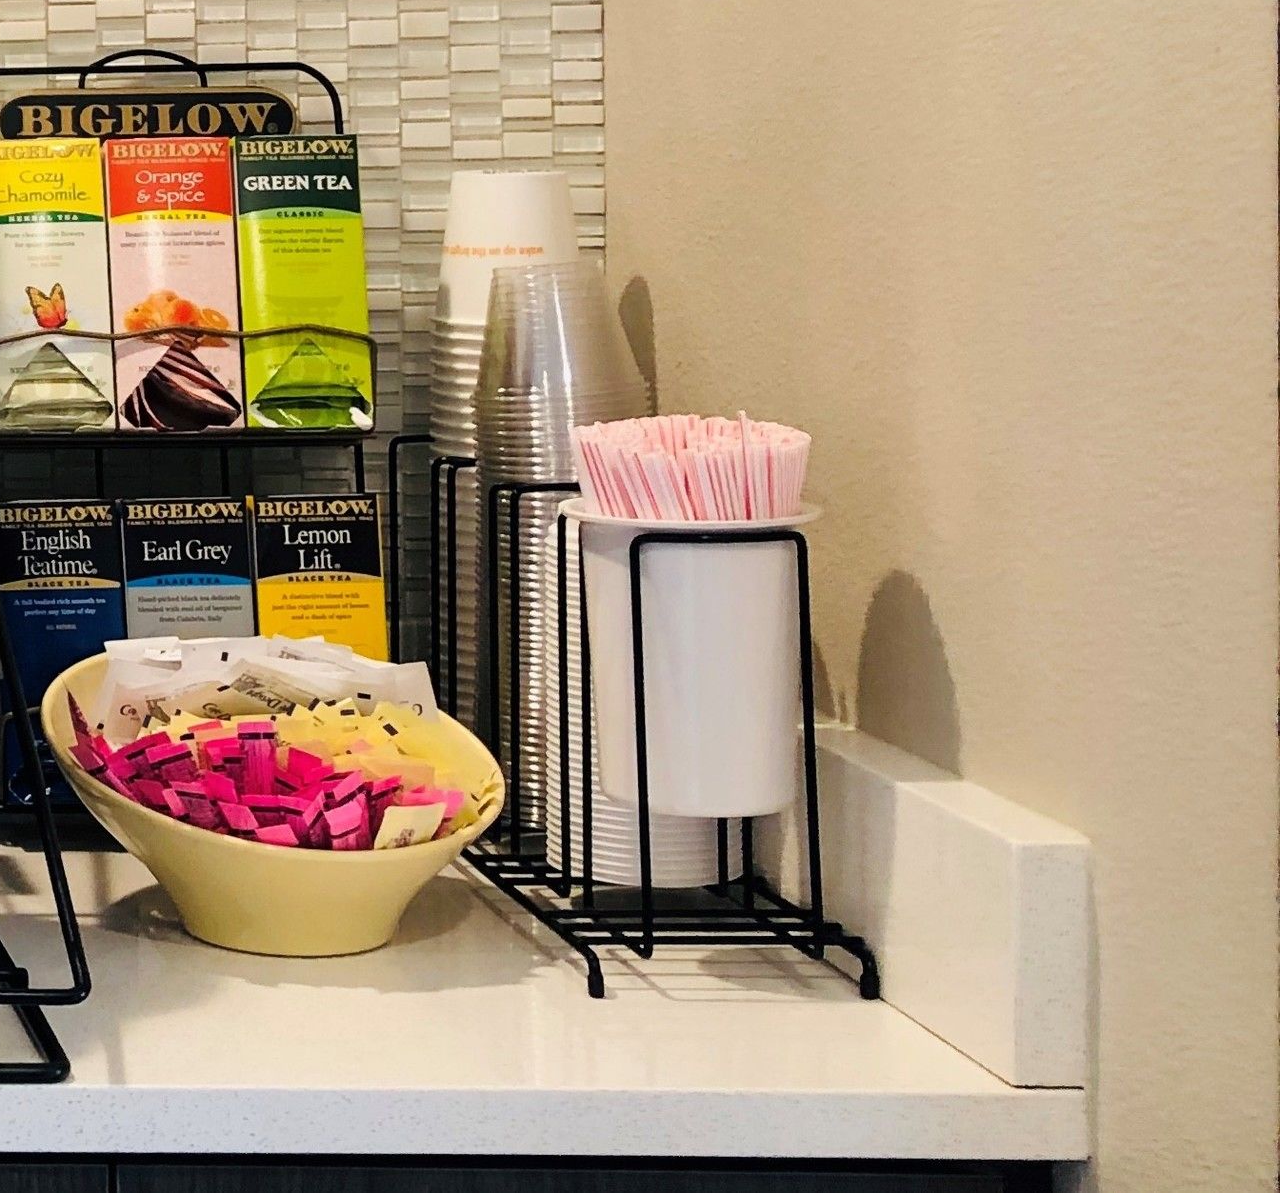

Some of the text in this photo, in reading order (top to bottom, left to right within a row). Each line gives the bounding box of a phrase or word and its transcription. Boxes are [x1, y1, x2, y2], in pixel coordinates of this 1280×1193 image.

[17, 103, 277, 136] BIGELOW
[111, 142, 223, 158] BIGELOW
[240, 139, 352, 155] BIGELOW
[19, 170, 64, 189] Cozy
[135, 170, 205, 190] Orange
[243, 175, 353, 191] GREEN TEA
[136, 189, 206, 210] & Spice
[126, 502, 241, 519] BIGELOW
[257, 499, 372, 517] BIGELOW
[21, 529, 91, 554] English
[282, 524, 352, 545] Lemon
[142, 539, 232, 564] Earl Grey
[17, 555, 93, 575] Teatime
